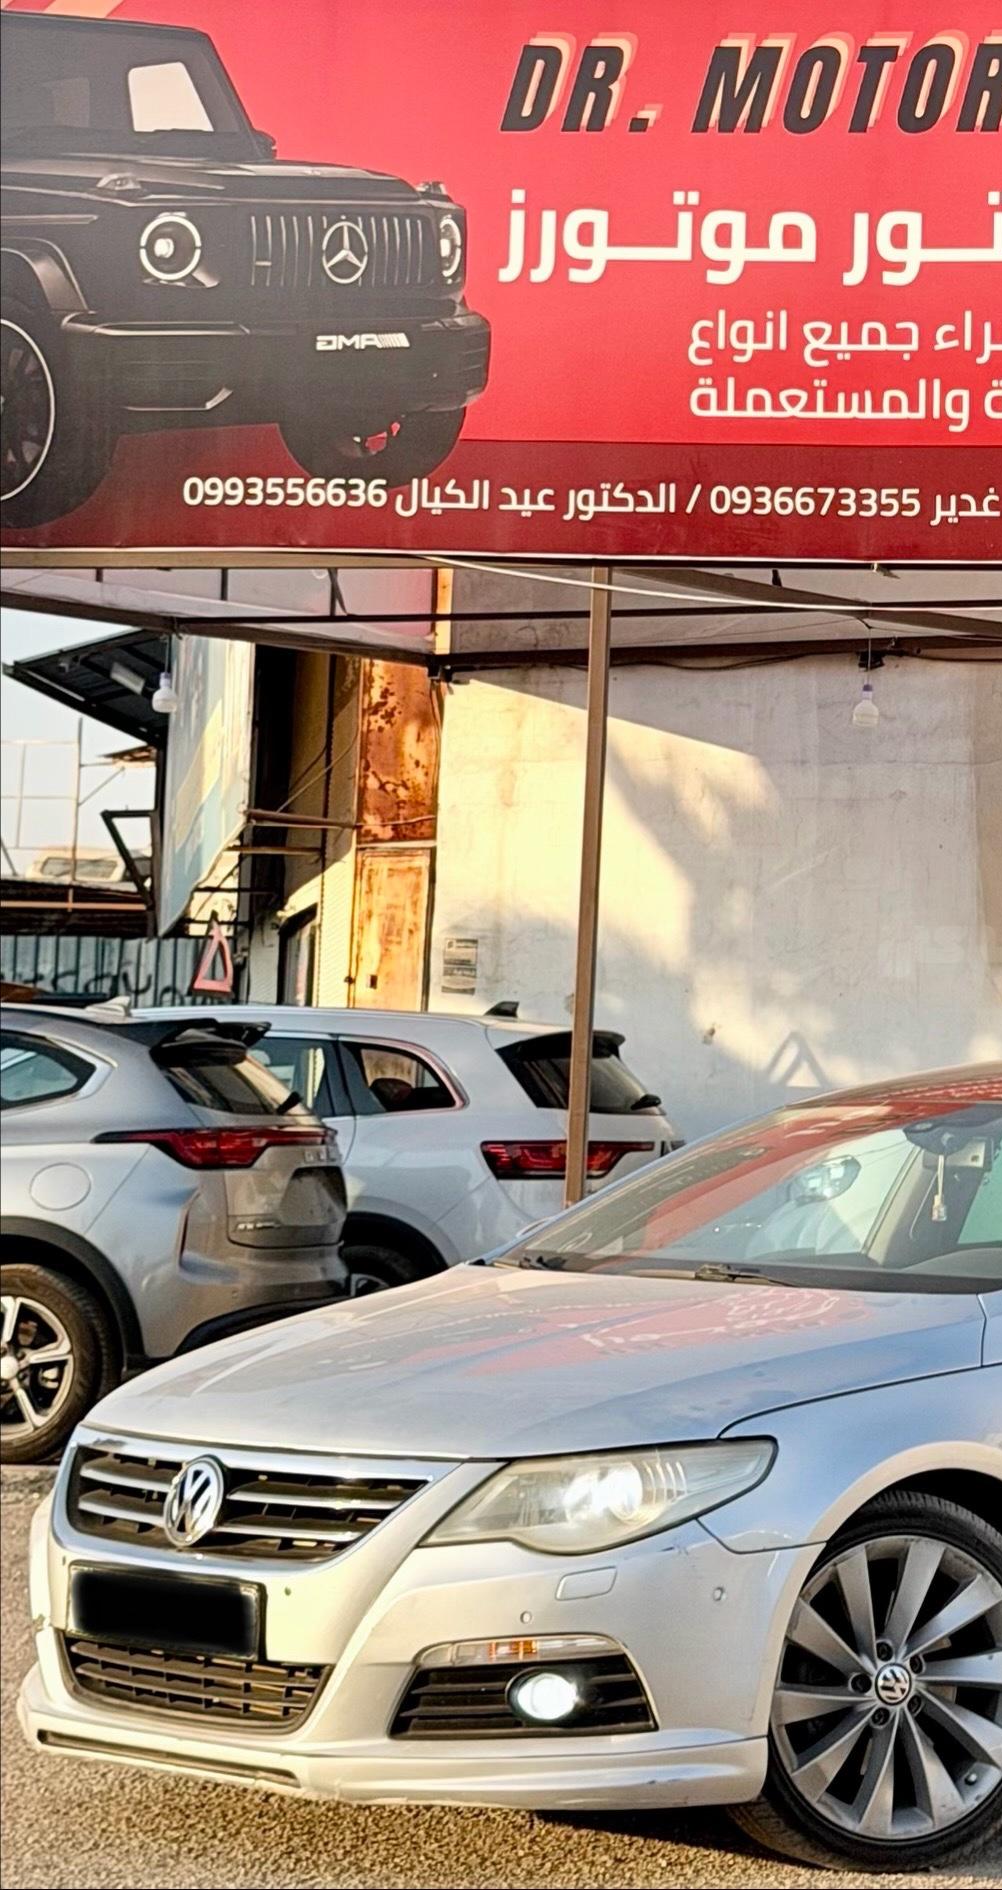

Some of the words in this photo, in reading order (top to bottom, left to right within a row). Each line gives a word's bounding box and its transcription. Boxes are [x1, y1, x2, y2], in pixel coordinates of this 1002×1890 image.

[500, 44, 649, 132] DR.
[497, 188, 817, 285] موتورز
[687, 309, 788, 366] انواع
[802, 320, 919, 368] جميع
[689, 376, 970, 433] والمستعملة
[183, 476, 388, 508] 0993556636
[395, 478, 490, 517] الكيال
[498, 487, 555, 517] عيد
[562, 482, 676, 521] الدكتور
[710, 485, 921, 517] 0936673355
[930, 487, 1001, 526] غدير
